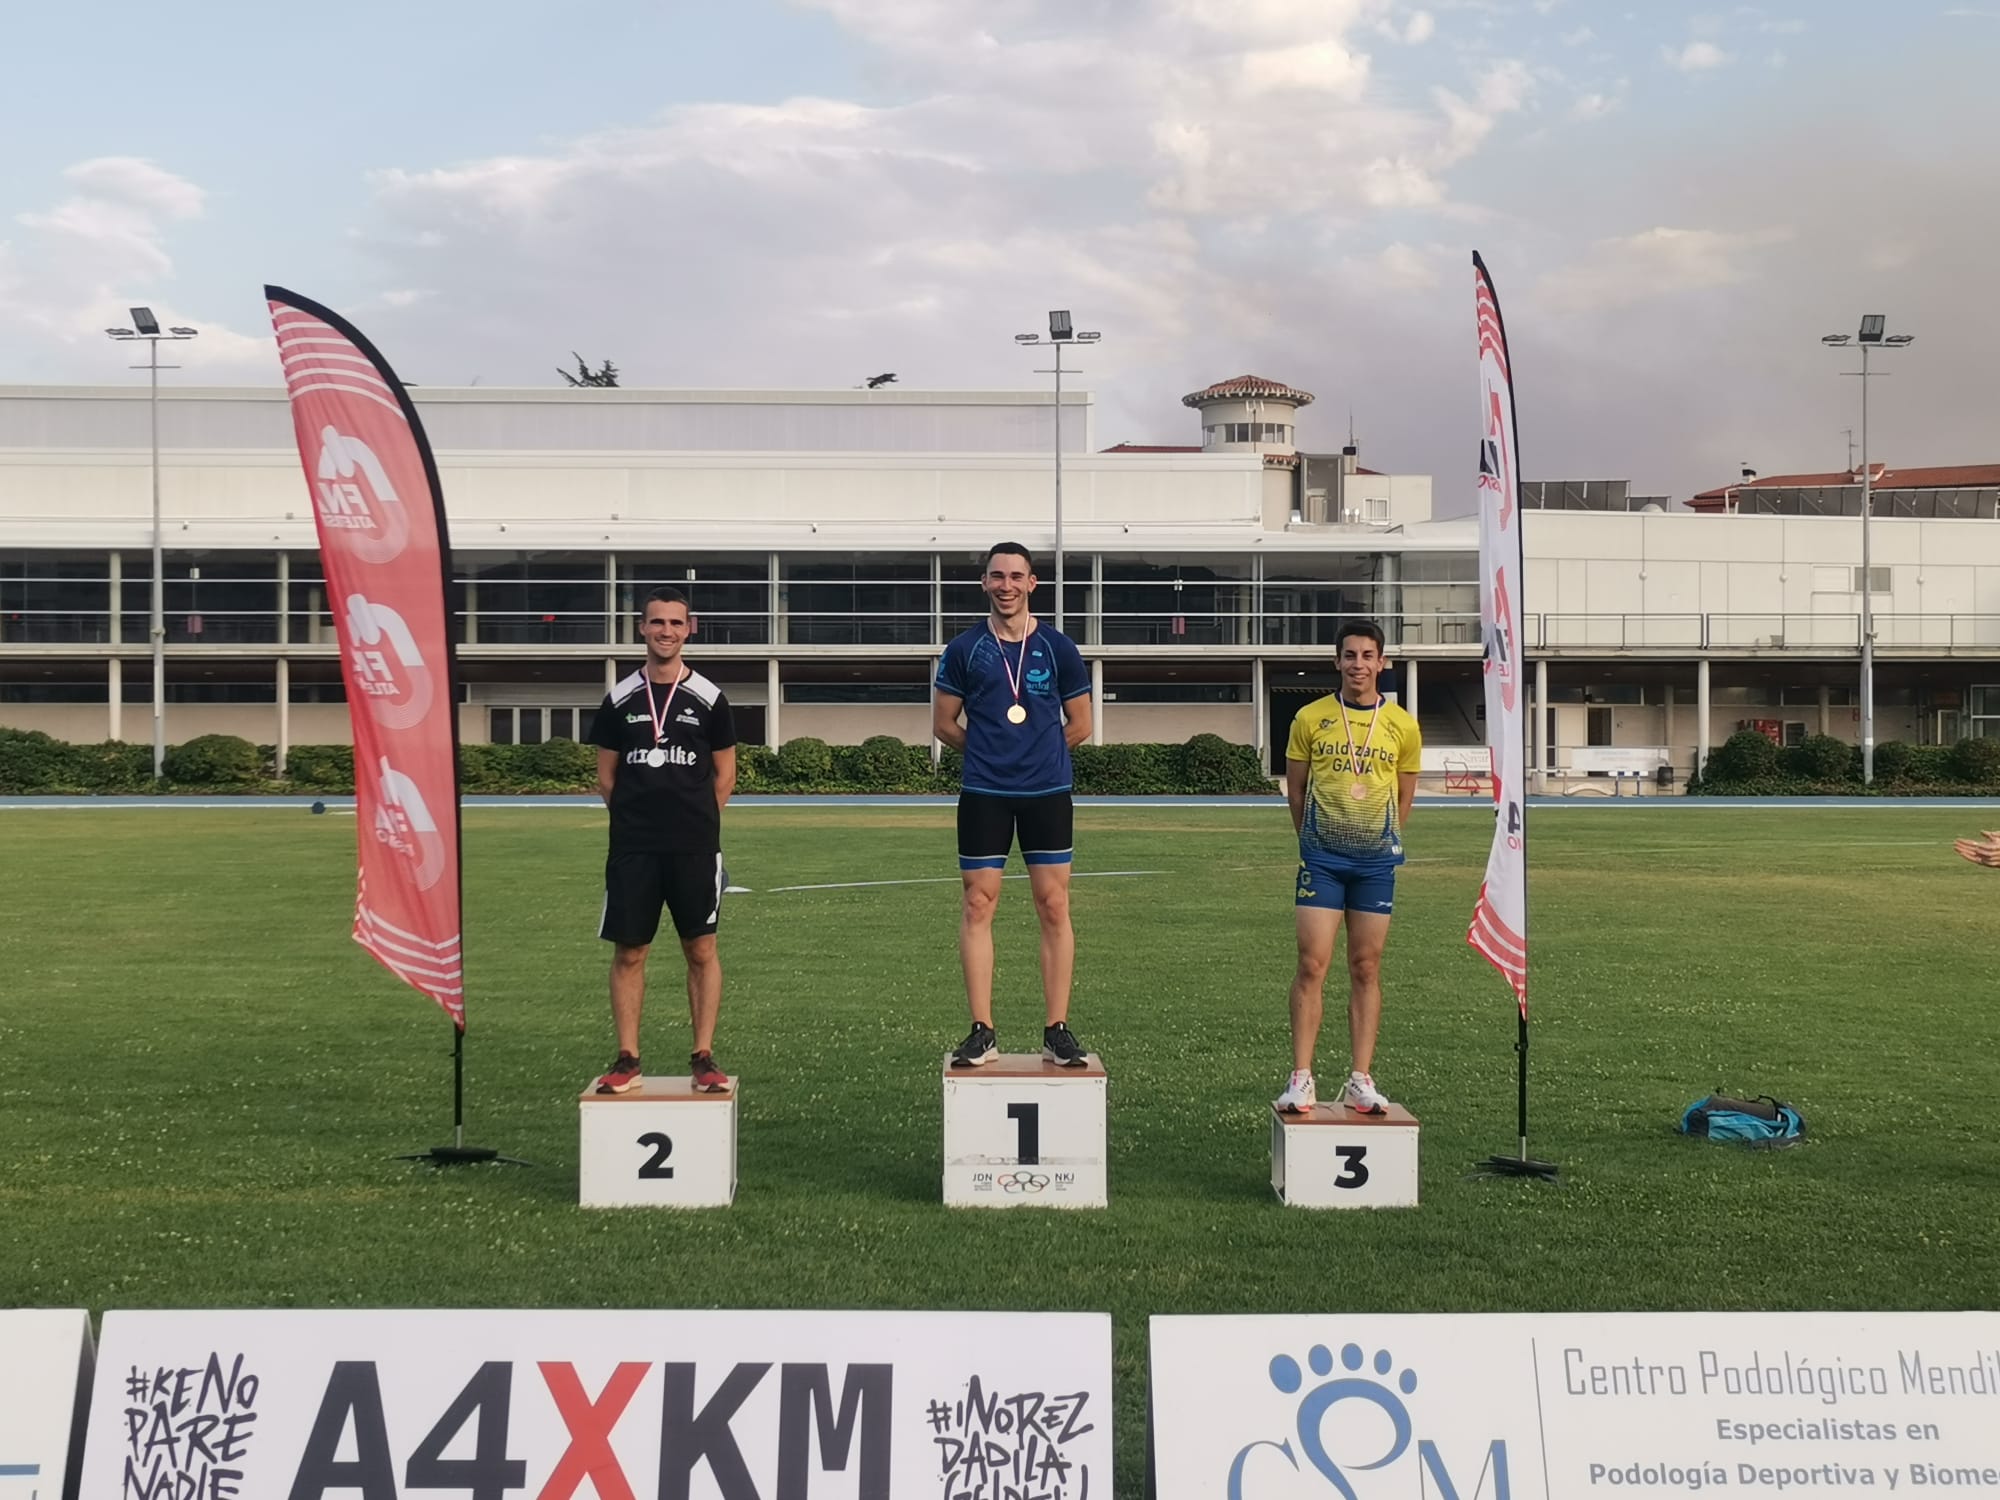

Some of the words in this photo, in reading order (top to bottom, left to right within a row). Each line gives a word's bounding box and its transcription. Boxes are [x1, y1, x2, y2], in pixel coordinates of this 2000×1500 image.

[1317, 740, 1394, 763] Valdzarbe
[636, 1132, 674, 1179] 2
[1007, 1102, 1039, 1165] 1
[973, 1173, 993, 1182] JDN
[1055, 1172, 1075, 1182] NKJ
[1333, 1145, 1369, 1189] 3
[1563, 1348, 1687, 1395] Centro
[1699, 1350, 1887, 1404] Podológico
[124, 1404, 257, 1470] PARE
[287, 1360, 894, 1500] A4XKM
[1716, 1419, 1897, 1445] Especialistas
[1906, 1423, 1940, 1440] en
[1589, 1461, 1727, 1490] Podología
[1737, 1463, 1874, 1490] Deportiva
[1883, 1467, 1899, 1490] y
[1909, 1463, 2000, 1485] Biome
